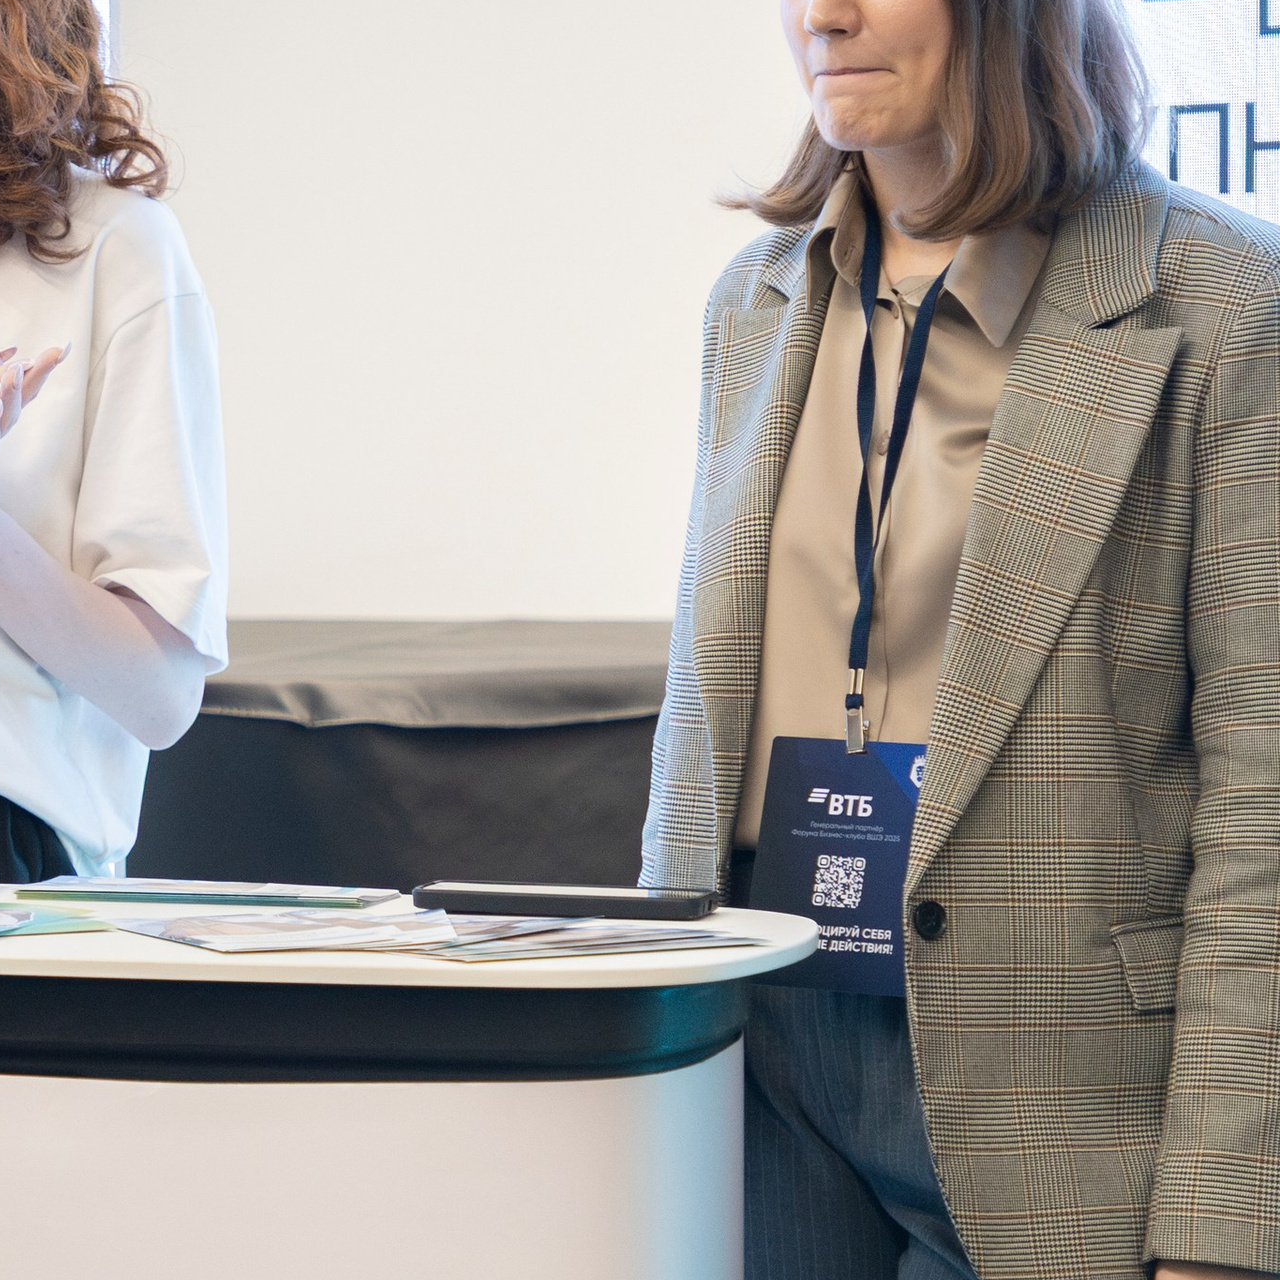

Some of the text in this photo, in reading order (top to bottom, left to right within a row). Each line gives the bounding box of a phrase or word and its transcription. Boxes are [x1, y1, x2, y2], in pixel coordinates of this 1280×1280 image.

[828, 793, 873, 817] ВТБ
[862, 928, 892, 941] СЕБЯ
[828, 939, 894, 955] ДЕЙСТВИЯ!
